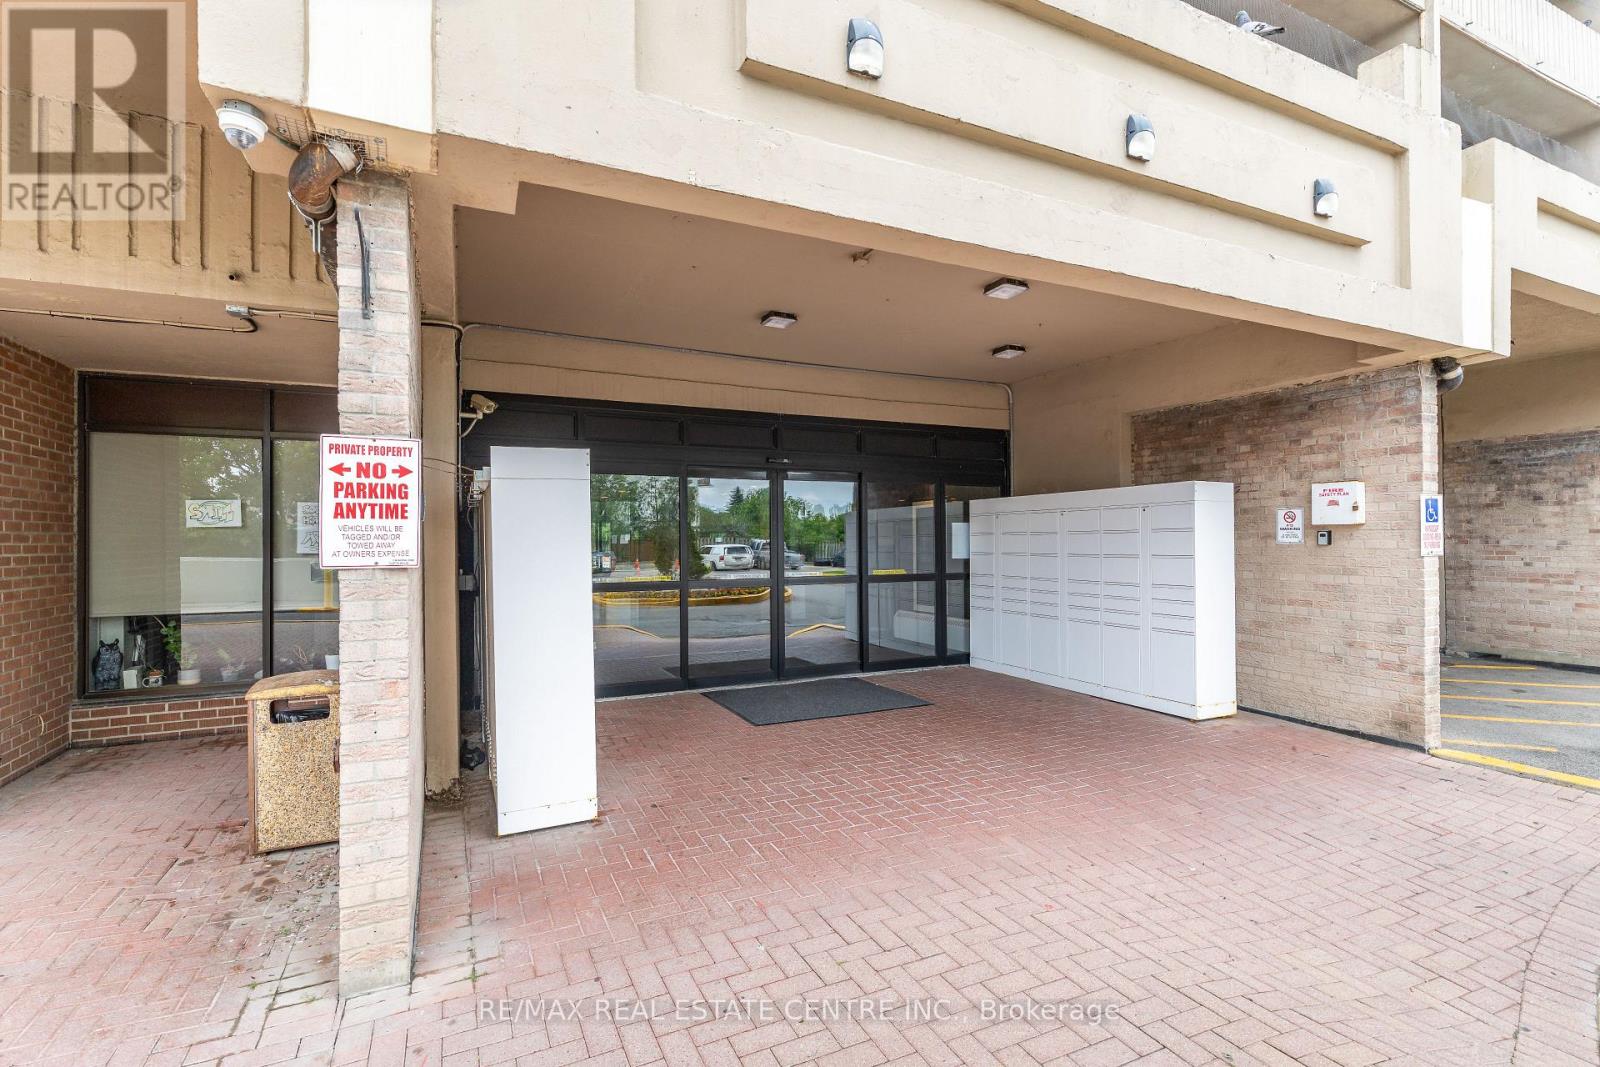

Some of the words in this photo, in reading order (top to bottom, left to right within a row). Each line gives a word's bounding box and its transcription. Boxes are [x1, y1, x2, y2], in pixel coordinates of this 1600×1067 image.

[328, 443, 366, 455] PRIVATE
[368, 445, 413, 457] PROPERTY
[355, 462, 387, 479] NO
[333, 481, 409, 500] PARKING
[333, 502, 408, 520] ANYTIME
[341, 533, 371, 541] TAGGED
[373, 533, 400, 541] AND/OR
[331, 550, 341, 558] AT
[342, 550, 376, 558] OWNERS
[377, 549, 410, 558] EXPENSE
